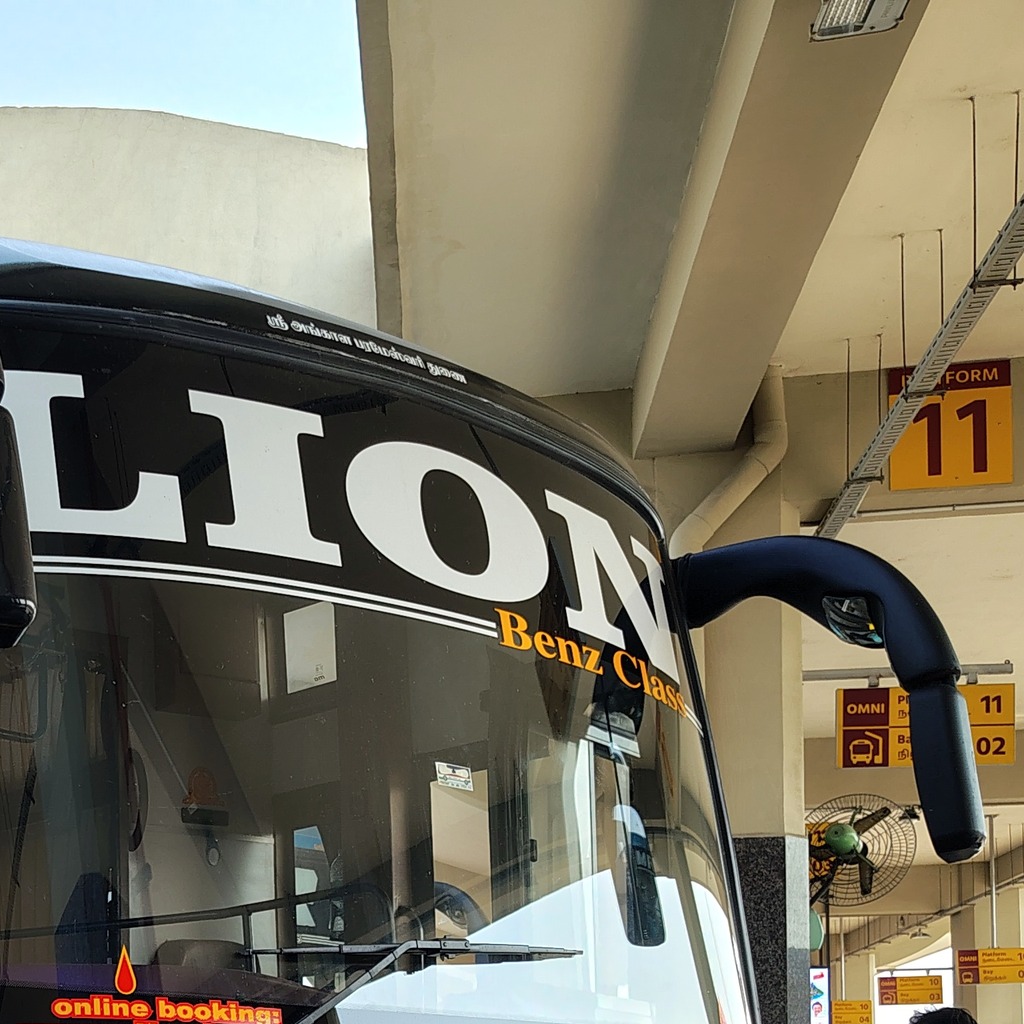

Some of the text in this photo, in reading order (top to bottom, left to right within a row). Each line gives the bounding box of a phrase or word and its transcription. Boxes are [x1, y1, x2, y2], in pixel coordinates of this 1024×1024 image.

[901, 367, 999, 388] FORM
[912, 398, 988, 477] 11
[0, 369, 680, 687] LION
[493, 607, 687, 718] Benz Class
[846, 702, 885, 715] OMNI
[980, 694, 1003, 714] 11
[976, 736, 1007, 756] 02
[959, 955, 978, 963] OMNI
[929, 978, 939, 986] 10
[859, 1003, 869, 1011] 10
[929, 993, 941, 1001] 03
[52, 996, 153, 1019] online
